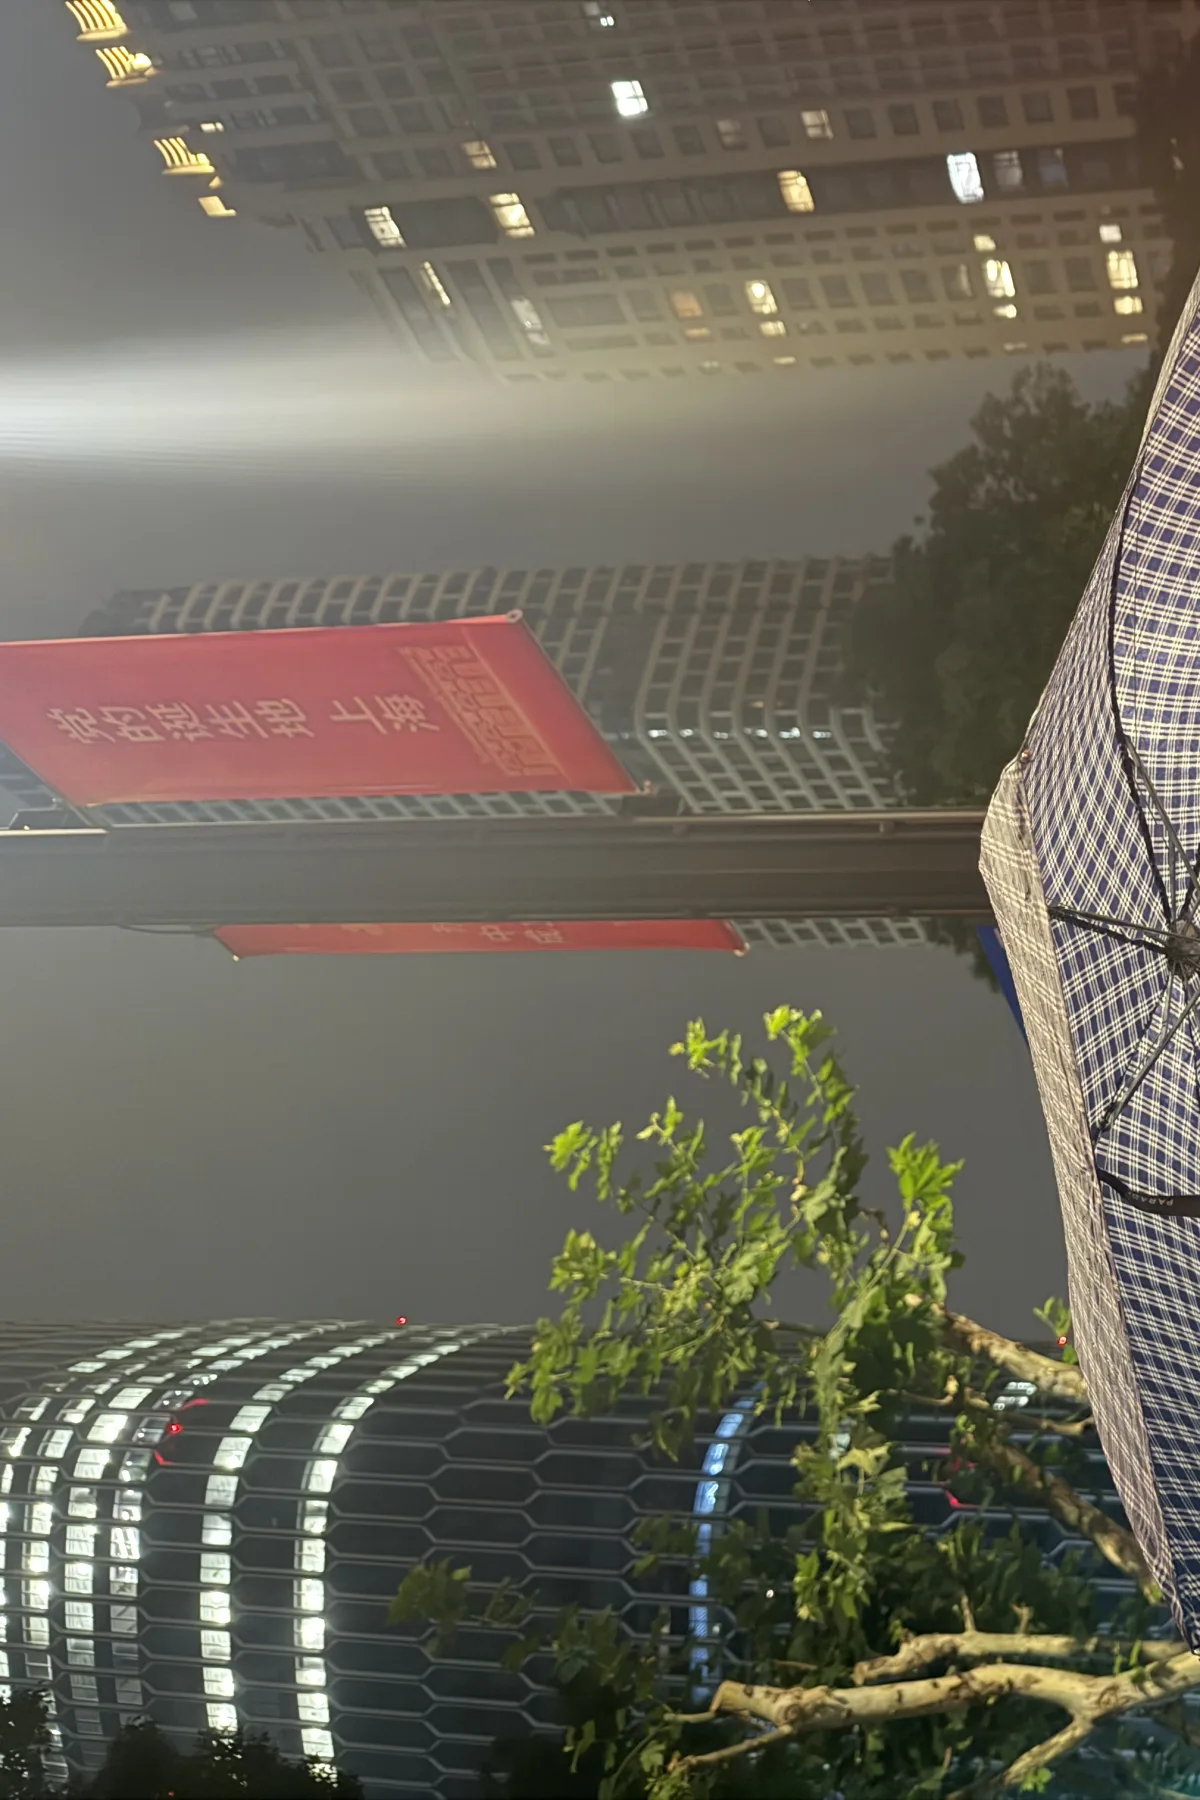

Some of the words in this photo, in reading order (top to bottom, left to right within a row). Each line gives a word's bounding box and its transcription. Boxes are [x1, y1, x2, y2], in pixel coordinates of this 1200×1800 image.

[46, 698, 315, 744] 党的诞生地
[330, 694, 441, 735] 上海
